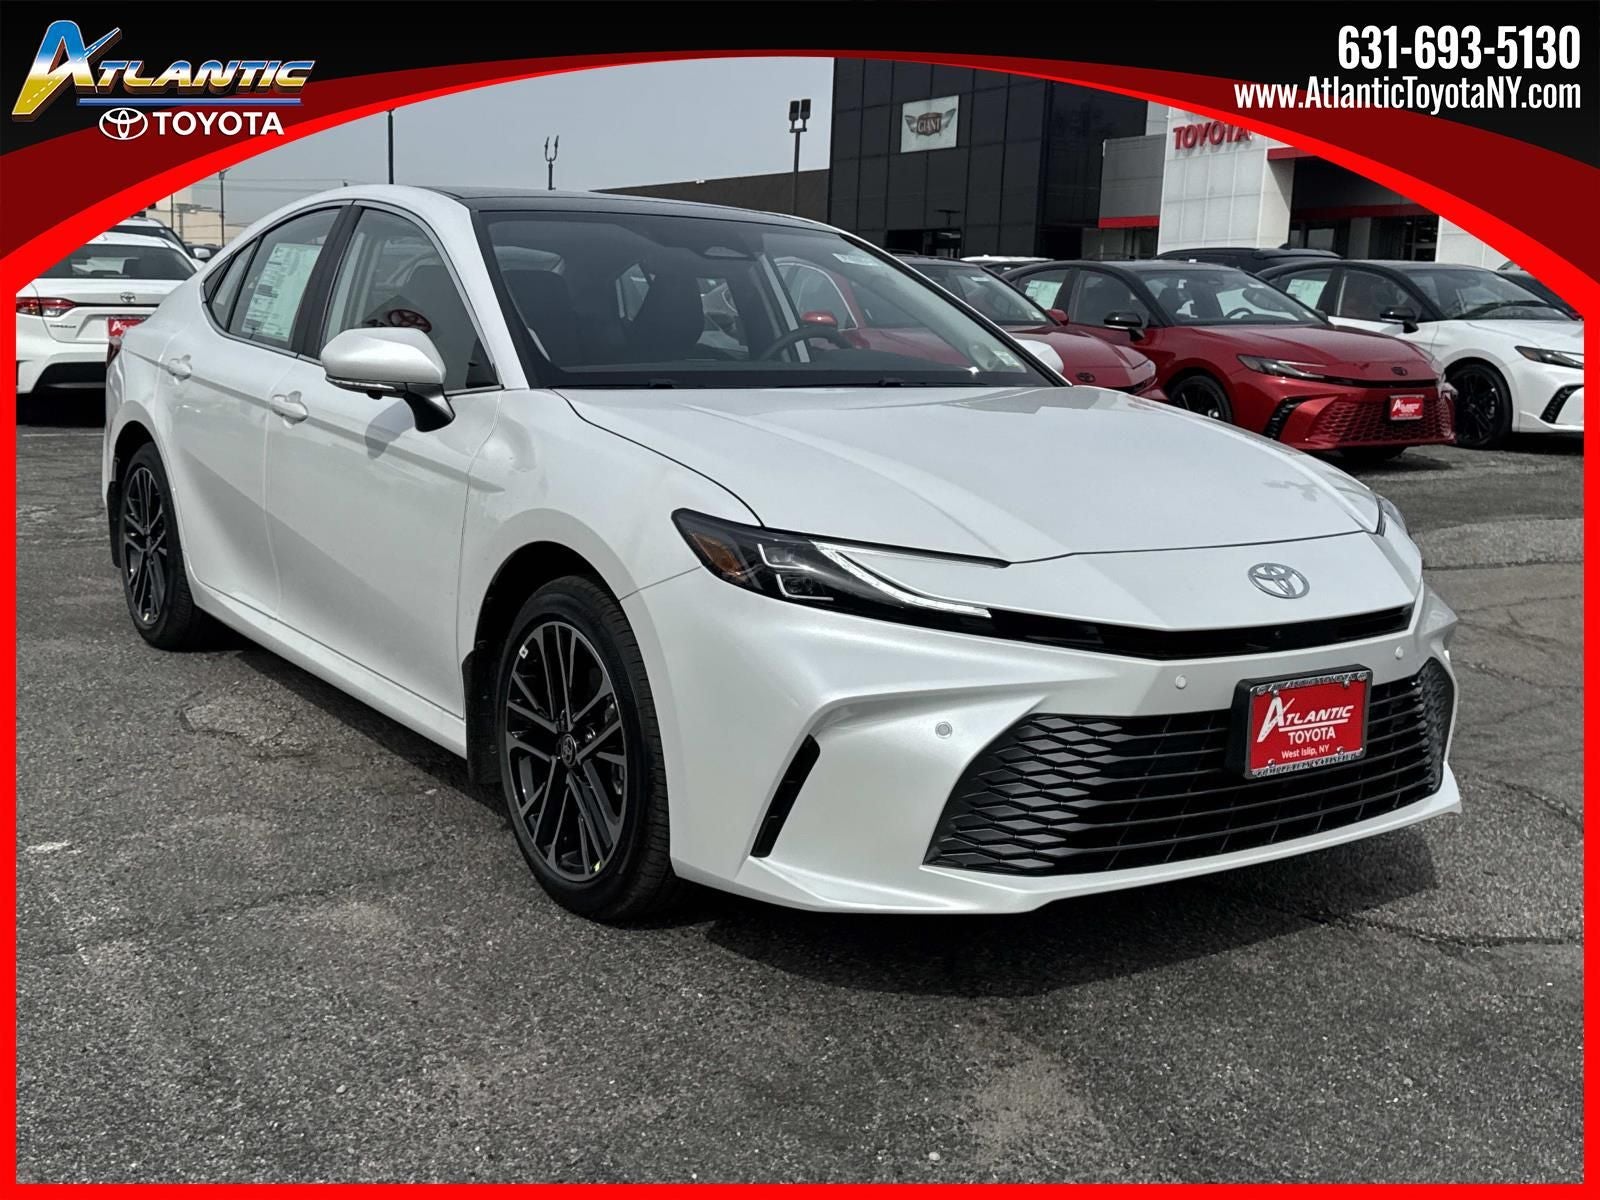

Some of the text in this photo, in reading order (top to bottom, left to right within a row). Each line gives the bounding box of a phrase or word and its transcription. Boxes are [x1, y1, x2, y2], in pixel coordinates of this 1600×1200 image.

[1173, 120, 1252, 151] TOYOTA
[1256, 697, 1354, 743] ATLANTIC
[1288, 726, 1336, 745] TOYOTA
[1281, 749, 1300, 760] West
[1318, 744, 1330, 755] NY
